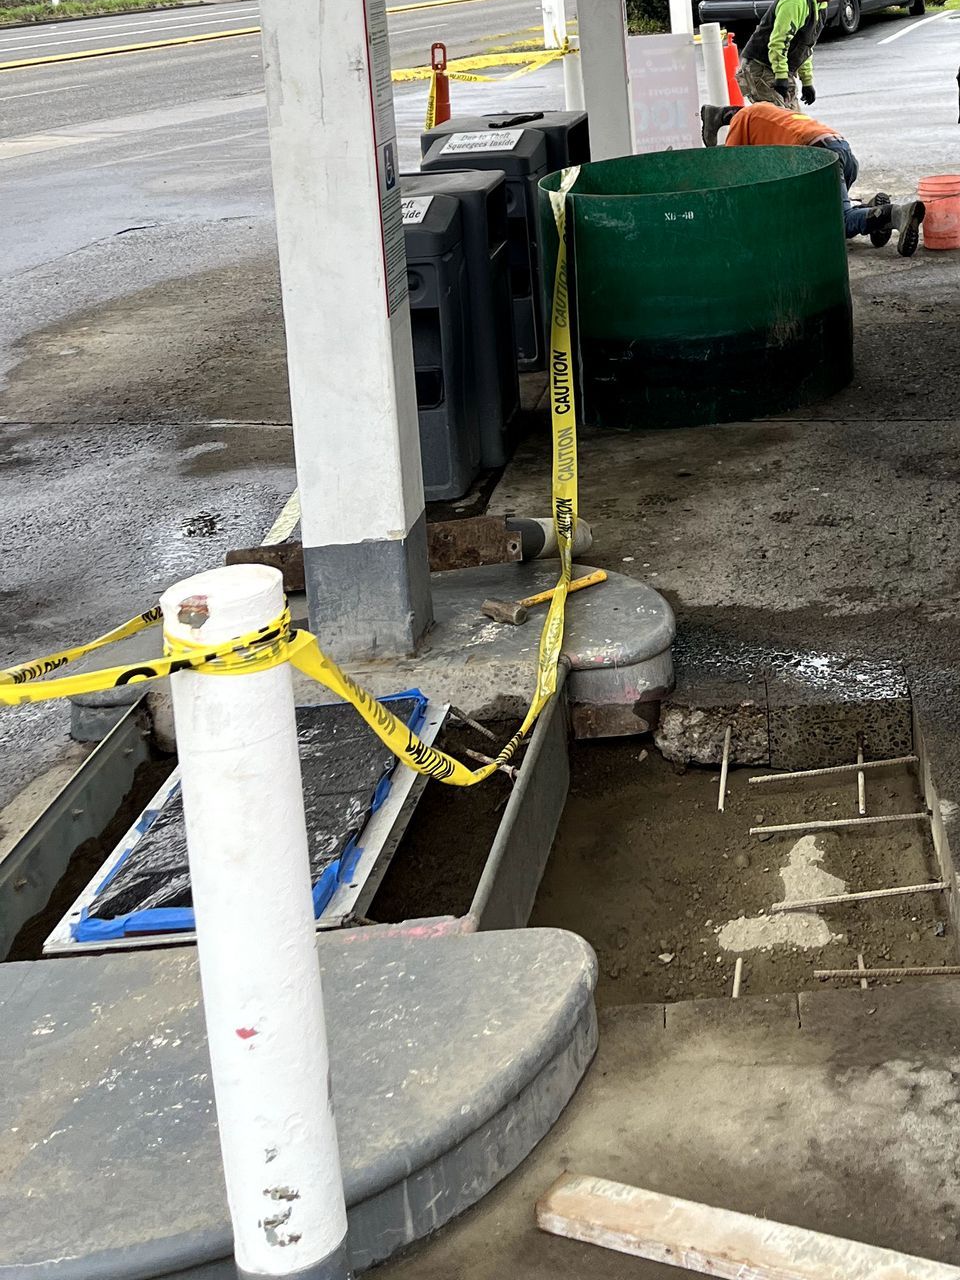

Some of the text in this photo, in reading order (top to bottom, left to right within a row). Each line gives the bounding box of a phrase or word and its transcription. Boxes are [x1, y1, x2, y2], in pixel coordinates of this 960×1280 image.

[490, 131, 511, 139] Theft
[446, 139, 515, 150] Squeegees Inside
[401, 200, 414, 209] eft
[553, 350, 571, 415] CAUTION
[557, 426, 574, 482] CAUTION
